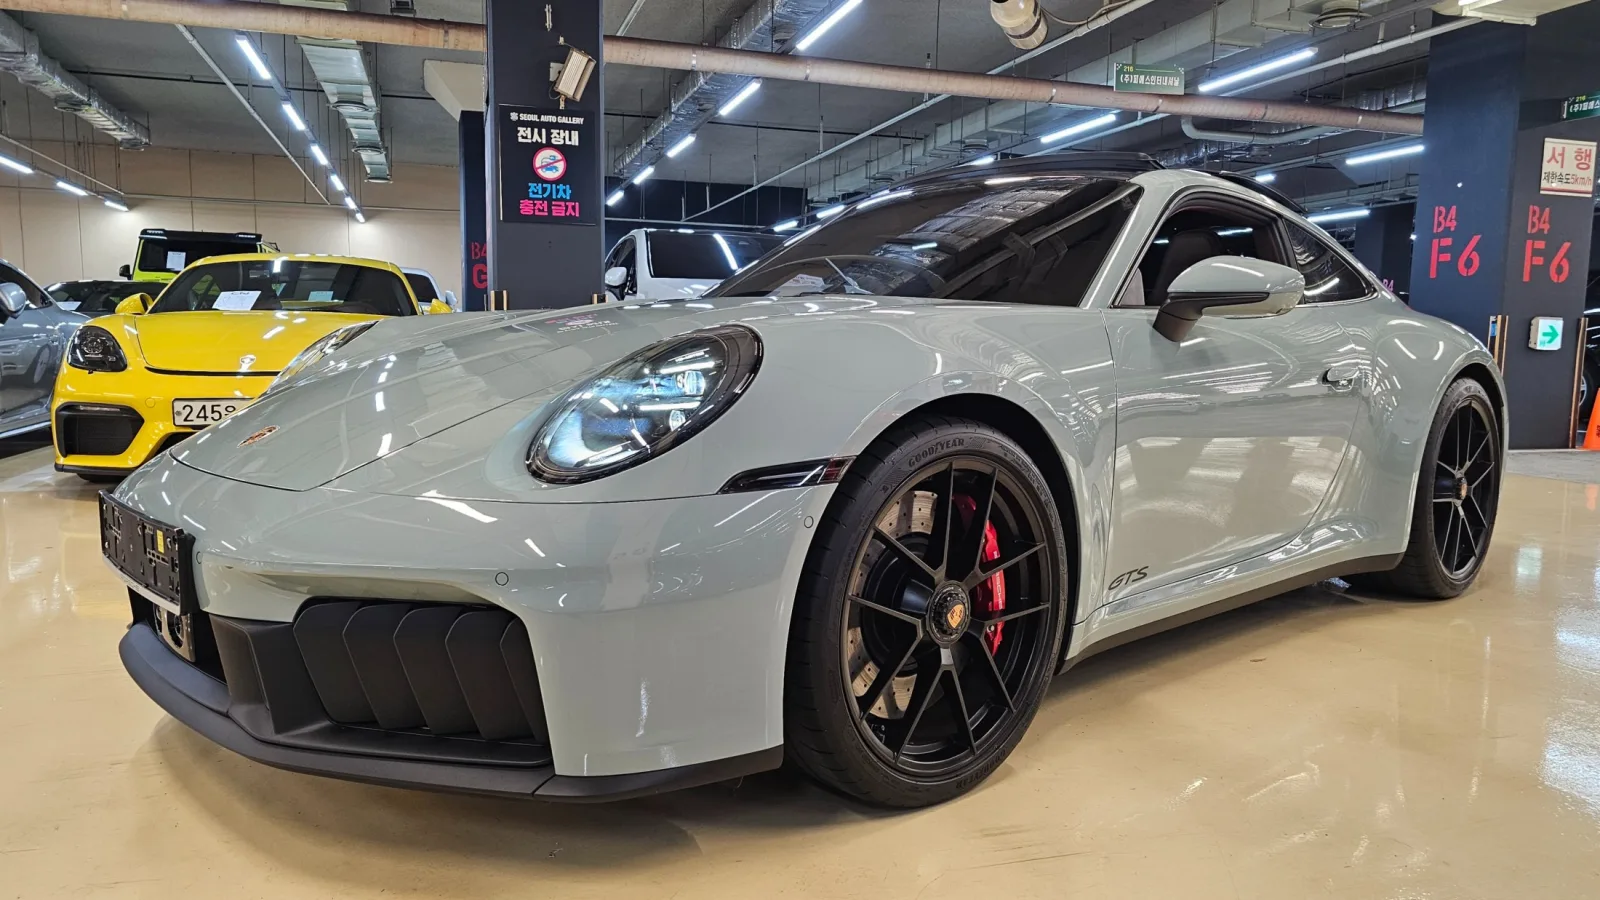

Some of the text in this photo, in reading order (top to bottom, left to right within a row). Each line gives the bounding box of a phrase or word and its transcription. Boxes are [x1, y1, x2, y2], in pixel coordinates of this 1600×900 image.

[519, 113, 584, 125] SEOUL AUTO GALLERY
[517, 127, 579, 146] 전시 장내
[528, 183, 572, 200] 전기차
[519, 199, 580, 217] 충전 금지
[1432, 205, 1457, 233] B4
[1527, 205, 1551, 234] B4
[908, 437, 965, 468] GOODYEAR
[1107, 565, 1150, 591] GTS
